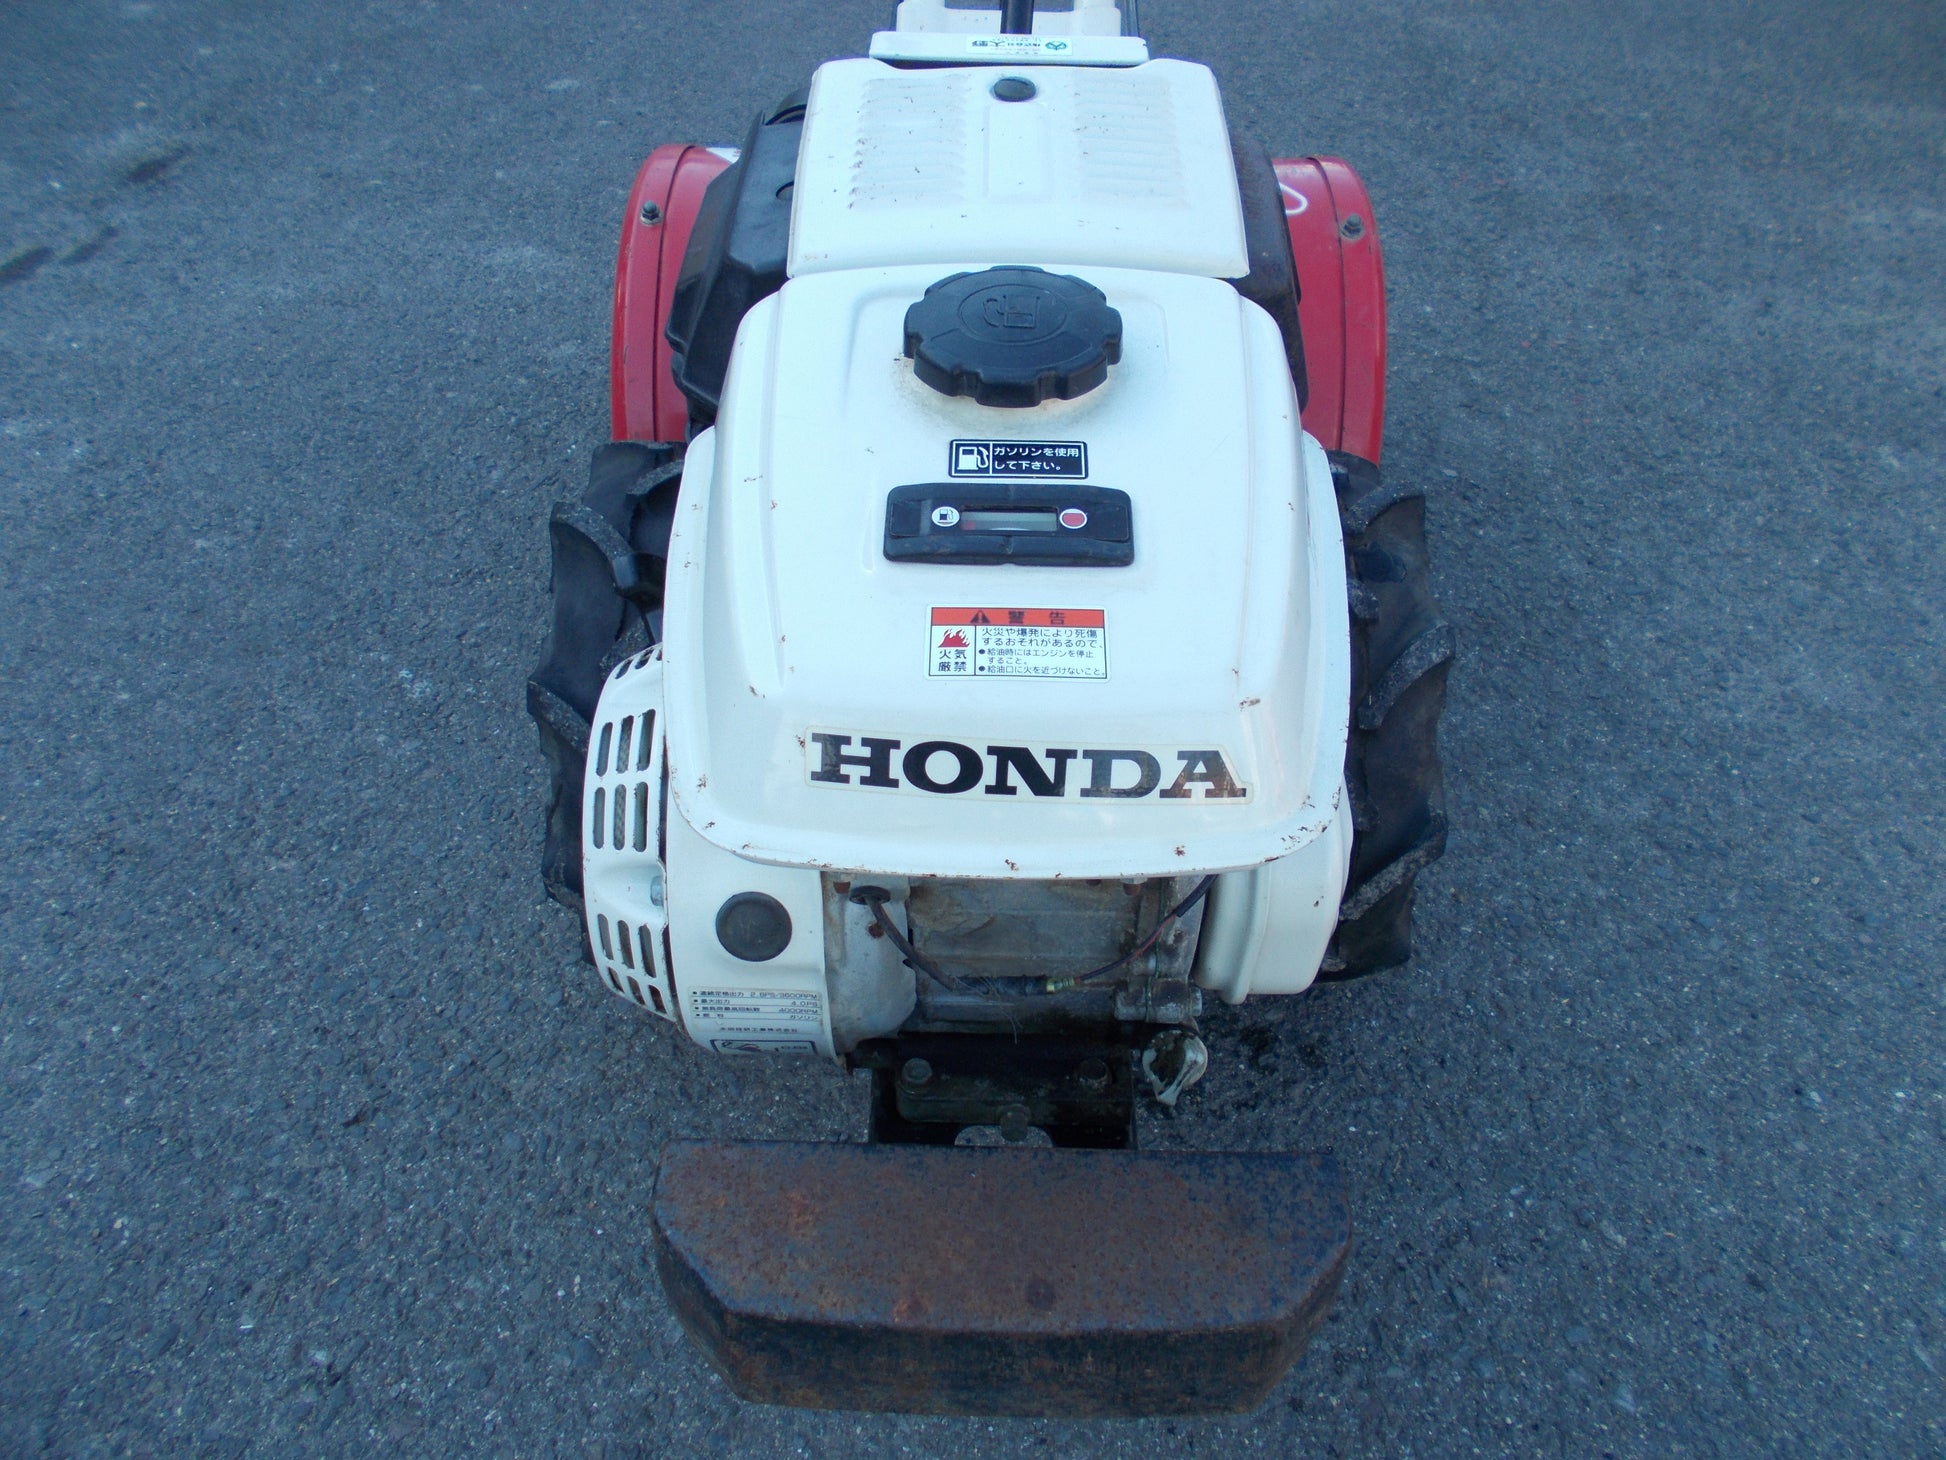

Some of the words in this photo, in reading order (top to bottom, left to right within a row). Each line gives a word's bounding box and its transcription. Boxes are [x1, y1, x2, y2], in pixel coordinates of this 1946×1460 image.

[993, 447, 1080, 458] ガソリンを使用
[993, 460, 1062, 471] して下さい。
[810, 732, 1248, 800] HONDA
